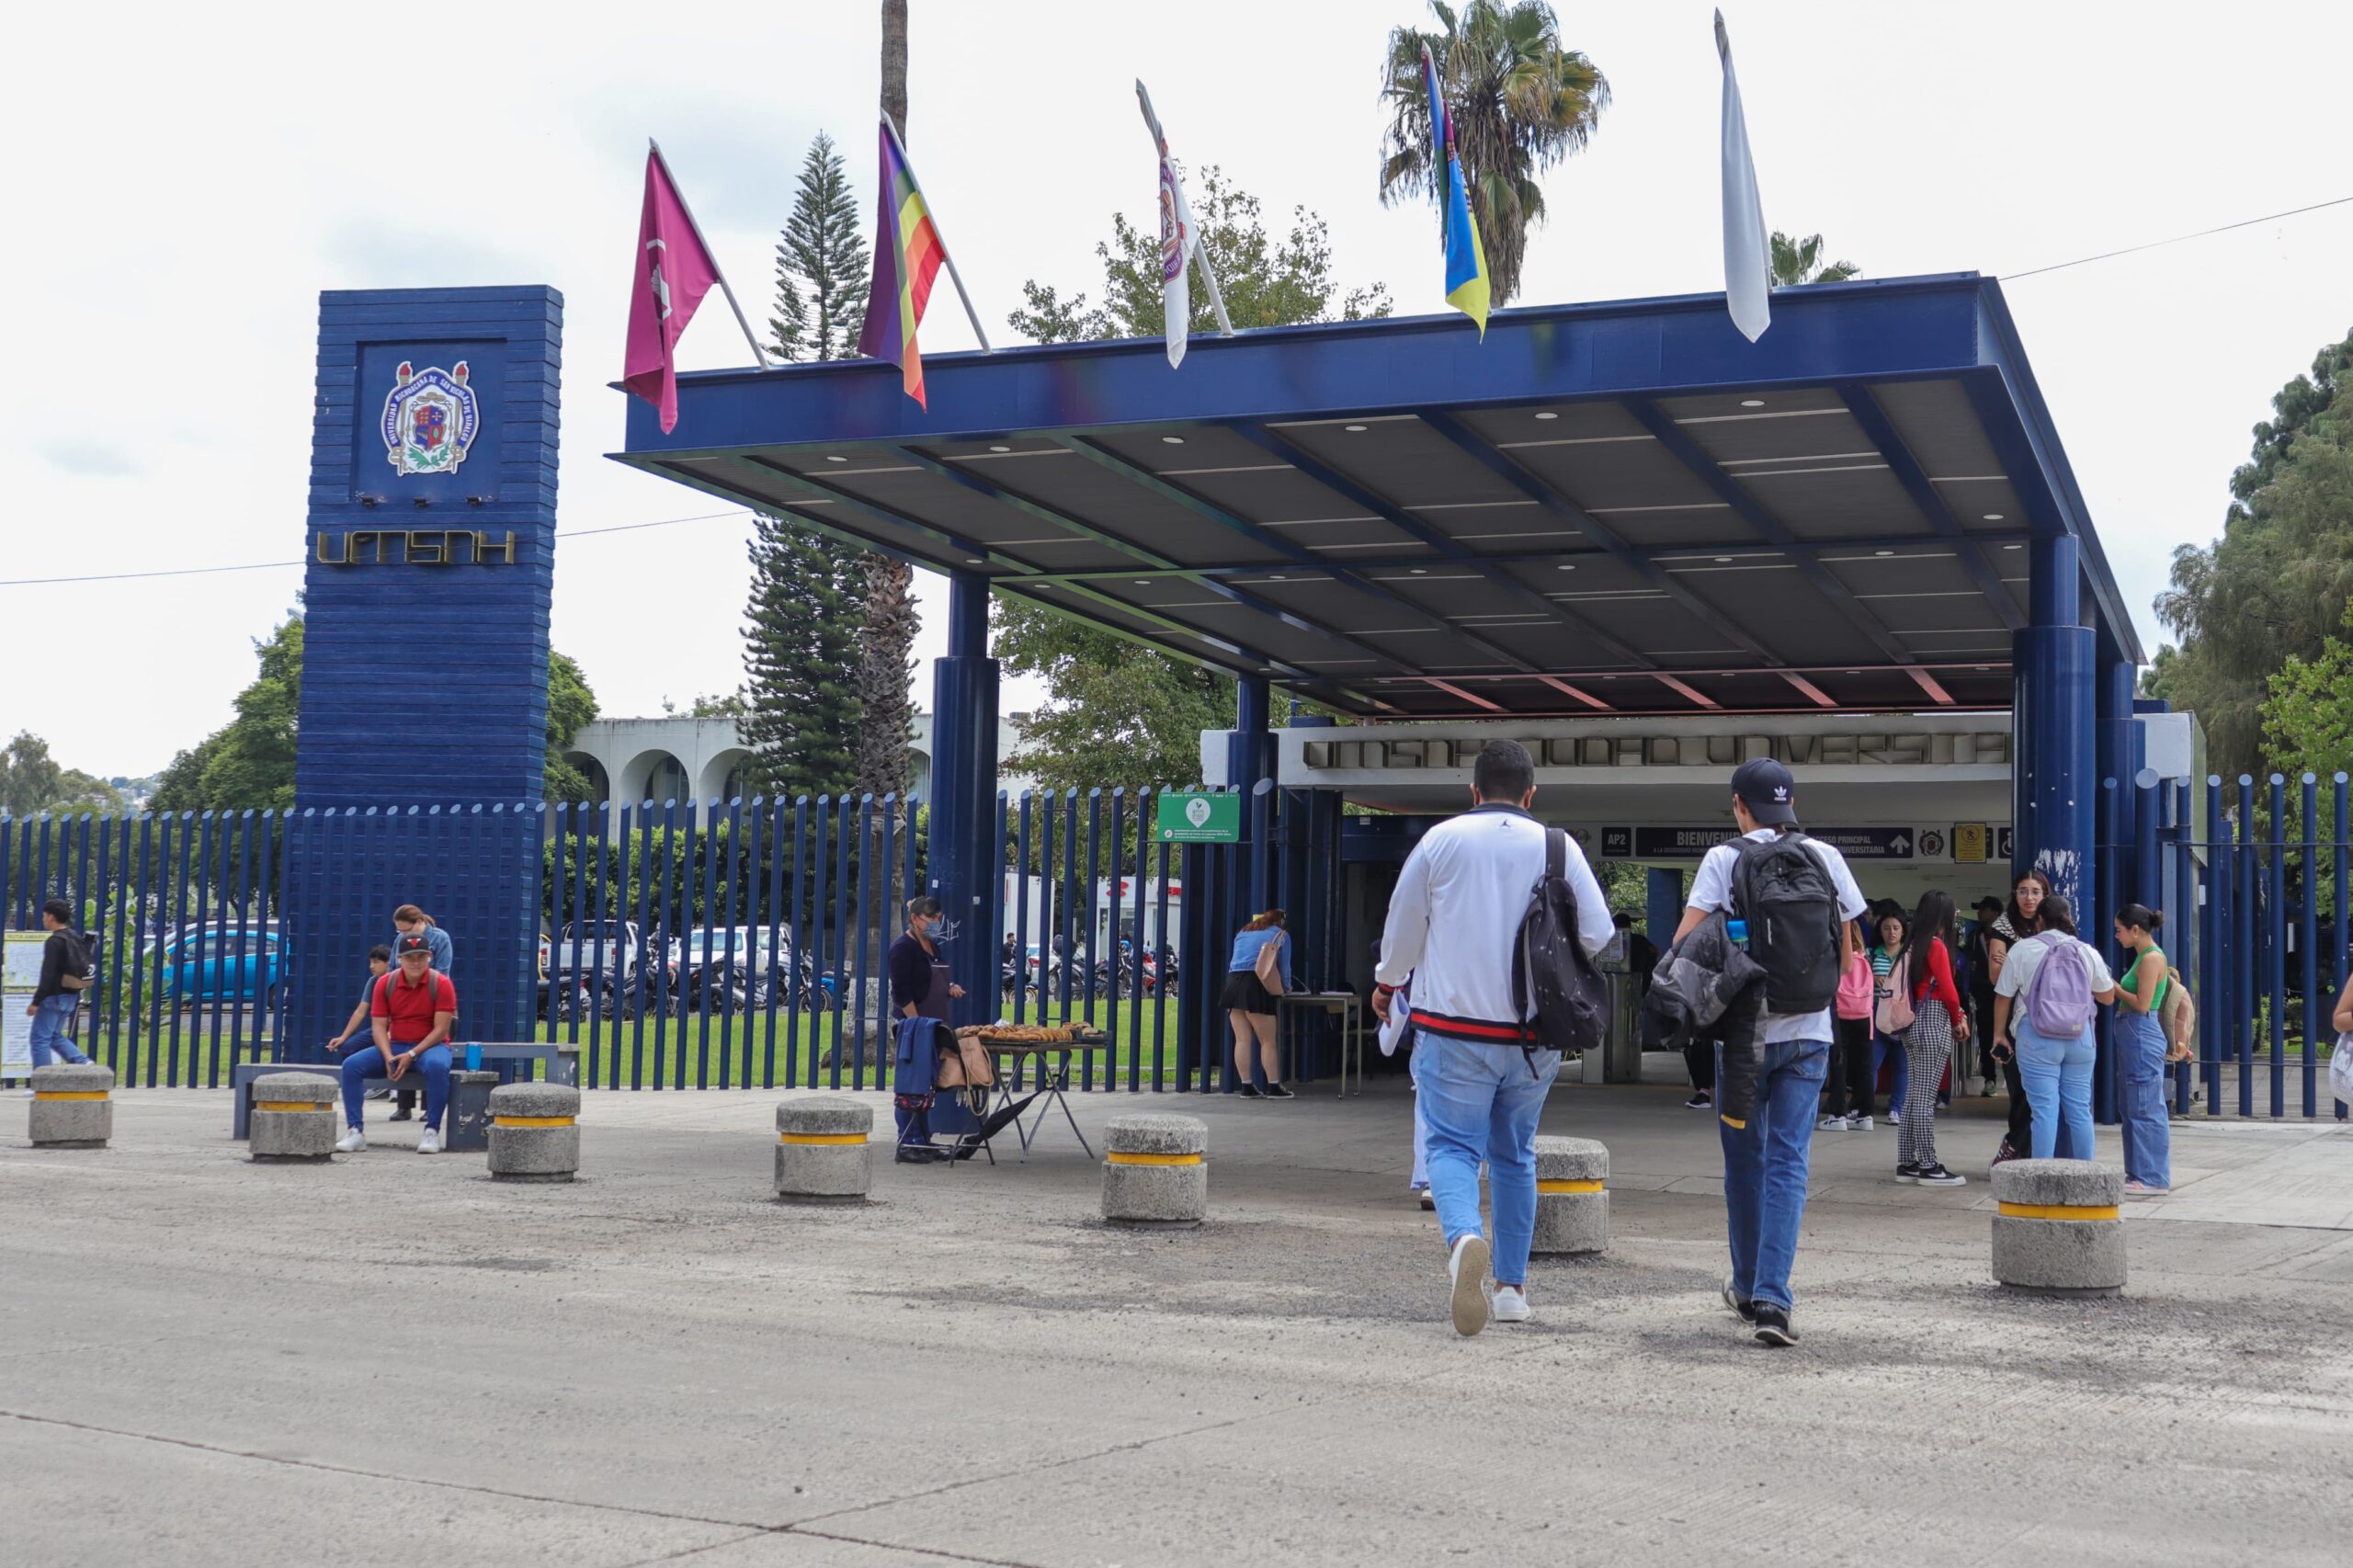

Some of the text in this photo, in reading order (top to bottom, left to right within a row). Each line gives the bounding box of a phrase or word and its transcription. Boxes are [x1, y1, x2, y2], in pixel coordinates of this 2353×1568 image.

[428, 374, 438, 383] DE
[439, 378, 451, 390] SAN
[394, 375, 428, 403] MICHOACANA
[462, 404, 472, 415] DE
[387, 403, 398, 445] UNIVERSIDAD
[460, 413, 473, 442] HIDALGO
[317, 529, 515, 564] UMSNH
[1518, 737, 1680, 767] IUDAD
[1608, 834, 1626, 846] AP2
[1837, 835, 1871, 844] PRINCIPAL
